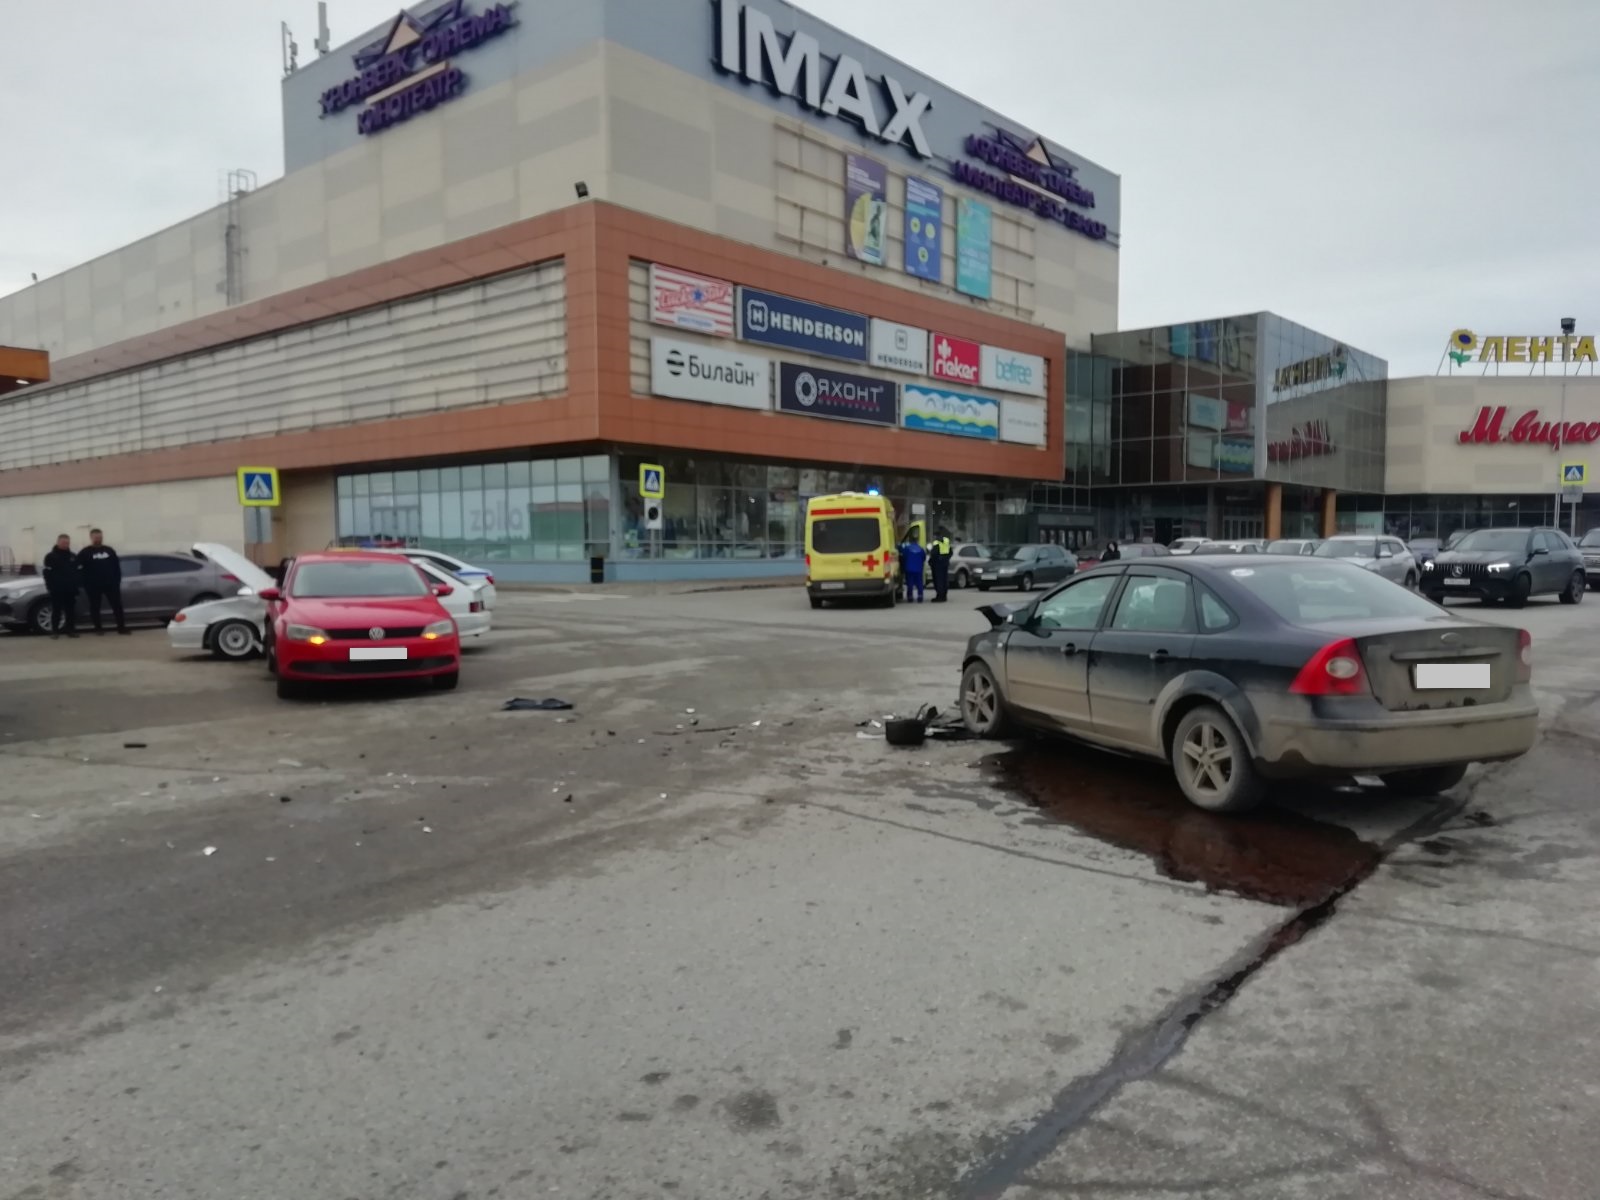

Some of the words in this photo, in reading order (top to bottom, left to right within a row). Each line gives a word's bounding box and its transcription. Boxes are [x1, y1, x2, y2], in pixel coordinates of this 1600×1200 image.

[716, 0, 933, 158] IMAX
[770, 312, 864, 347] HENDERSON
[877, 354, 924, 369] HENDERSON
[1479, 335, 1599, 362] ЛЕНТА
[689, 355, 755, 387] Билайн
[935, 356, 978, 380] rieker
[995, 354, 1032, 385] befree
[817, 378, 878, 404] ЯХОНТ
